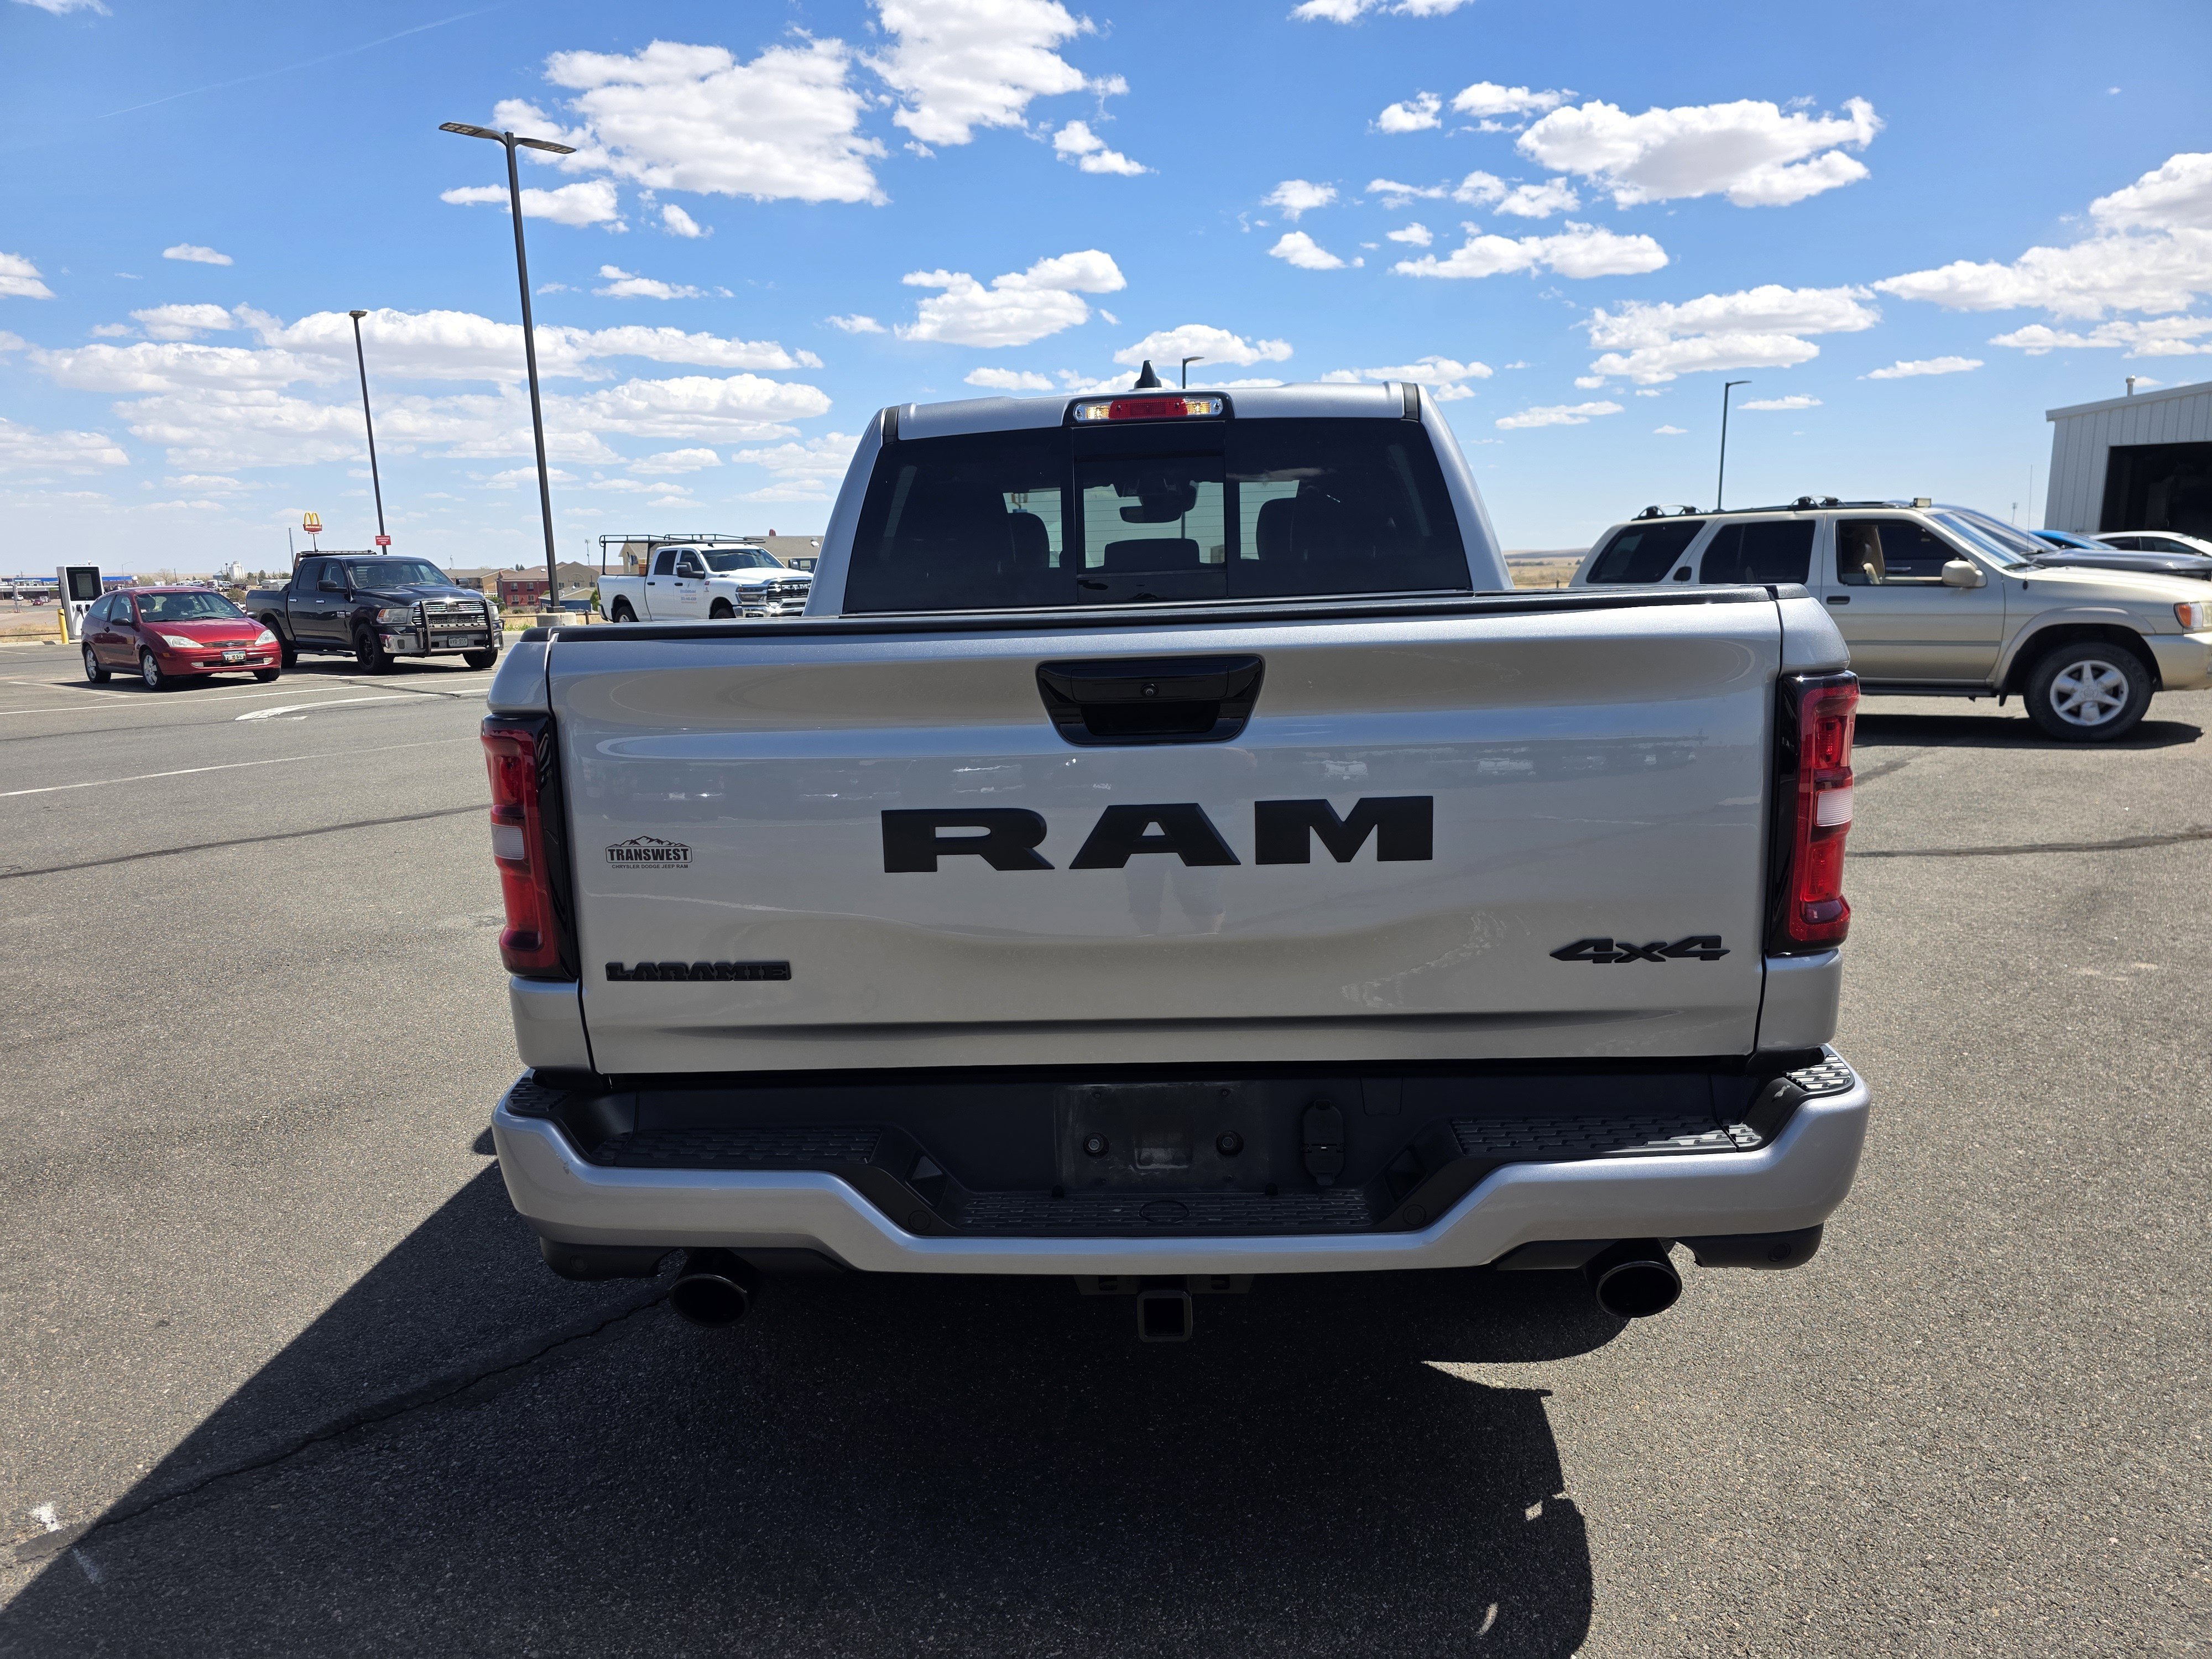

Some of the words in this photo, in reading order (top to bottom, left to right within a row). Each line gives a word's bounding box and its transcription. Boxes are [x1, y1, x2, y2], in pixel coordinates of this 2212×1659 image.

[881, 796, 1433, 873] RAM
[608, 848, 689, 861] TRANSWEST
[606, 961, 791, 981] LARAMIE
